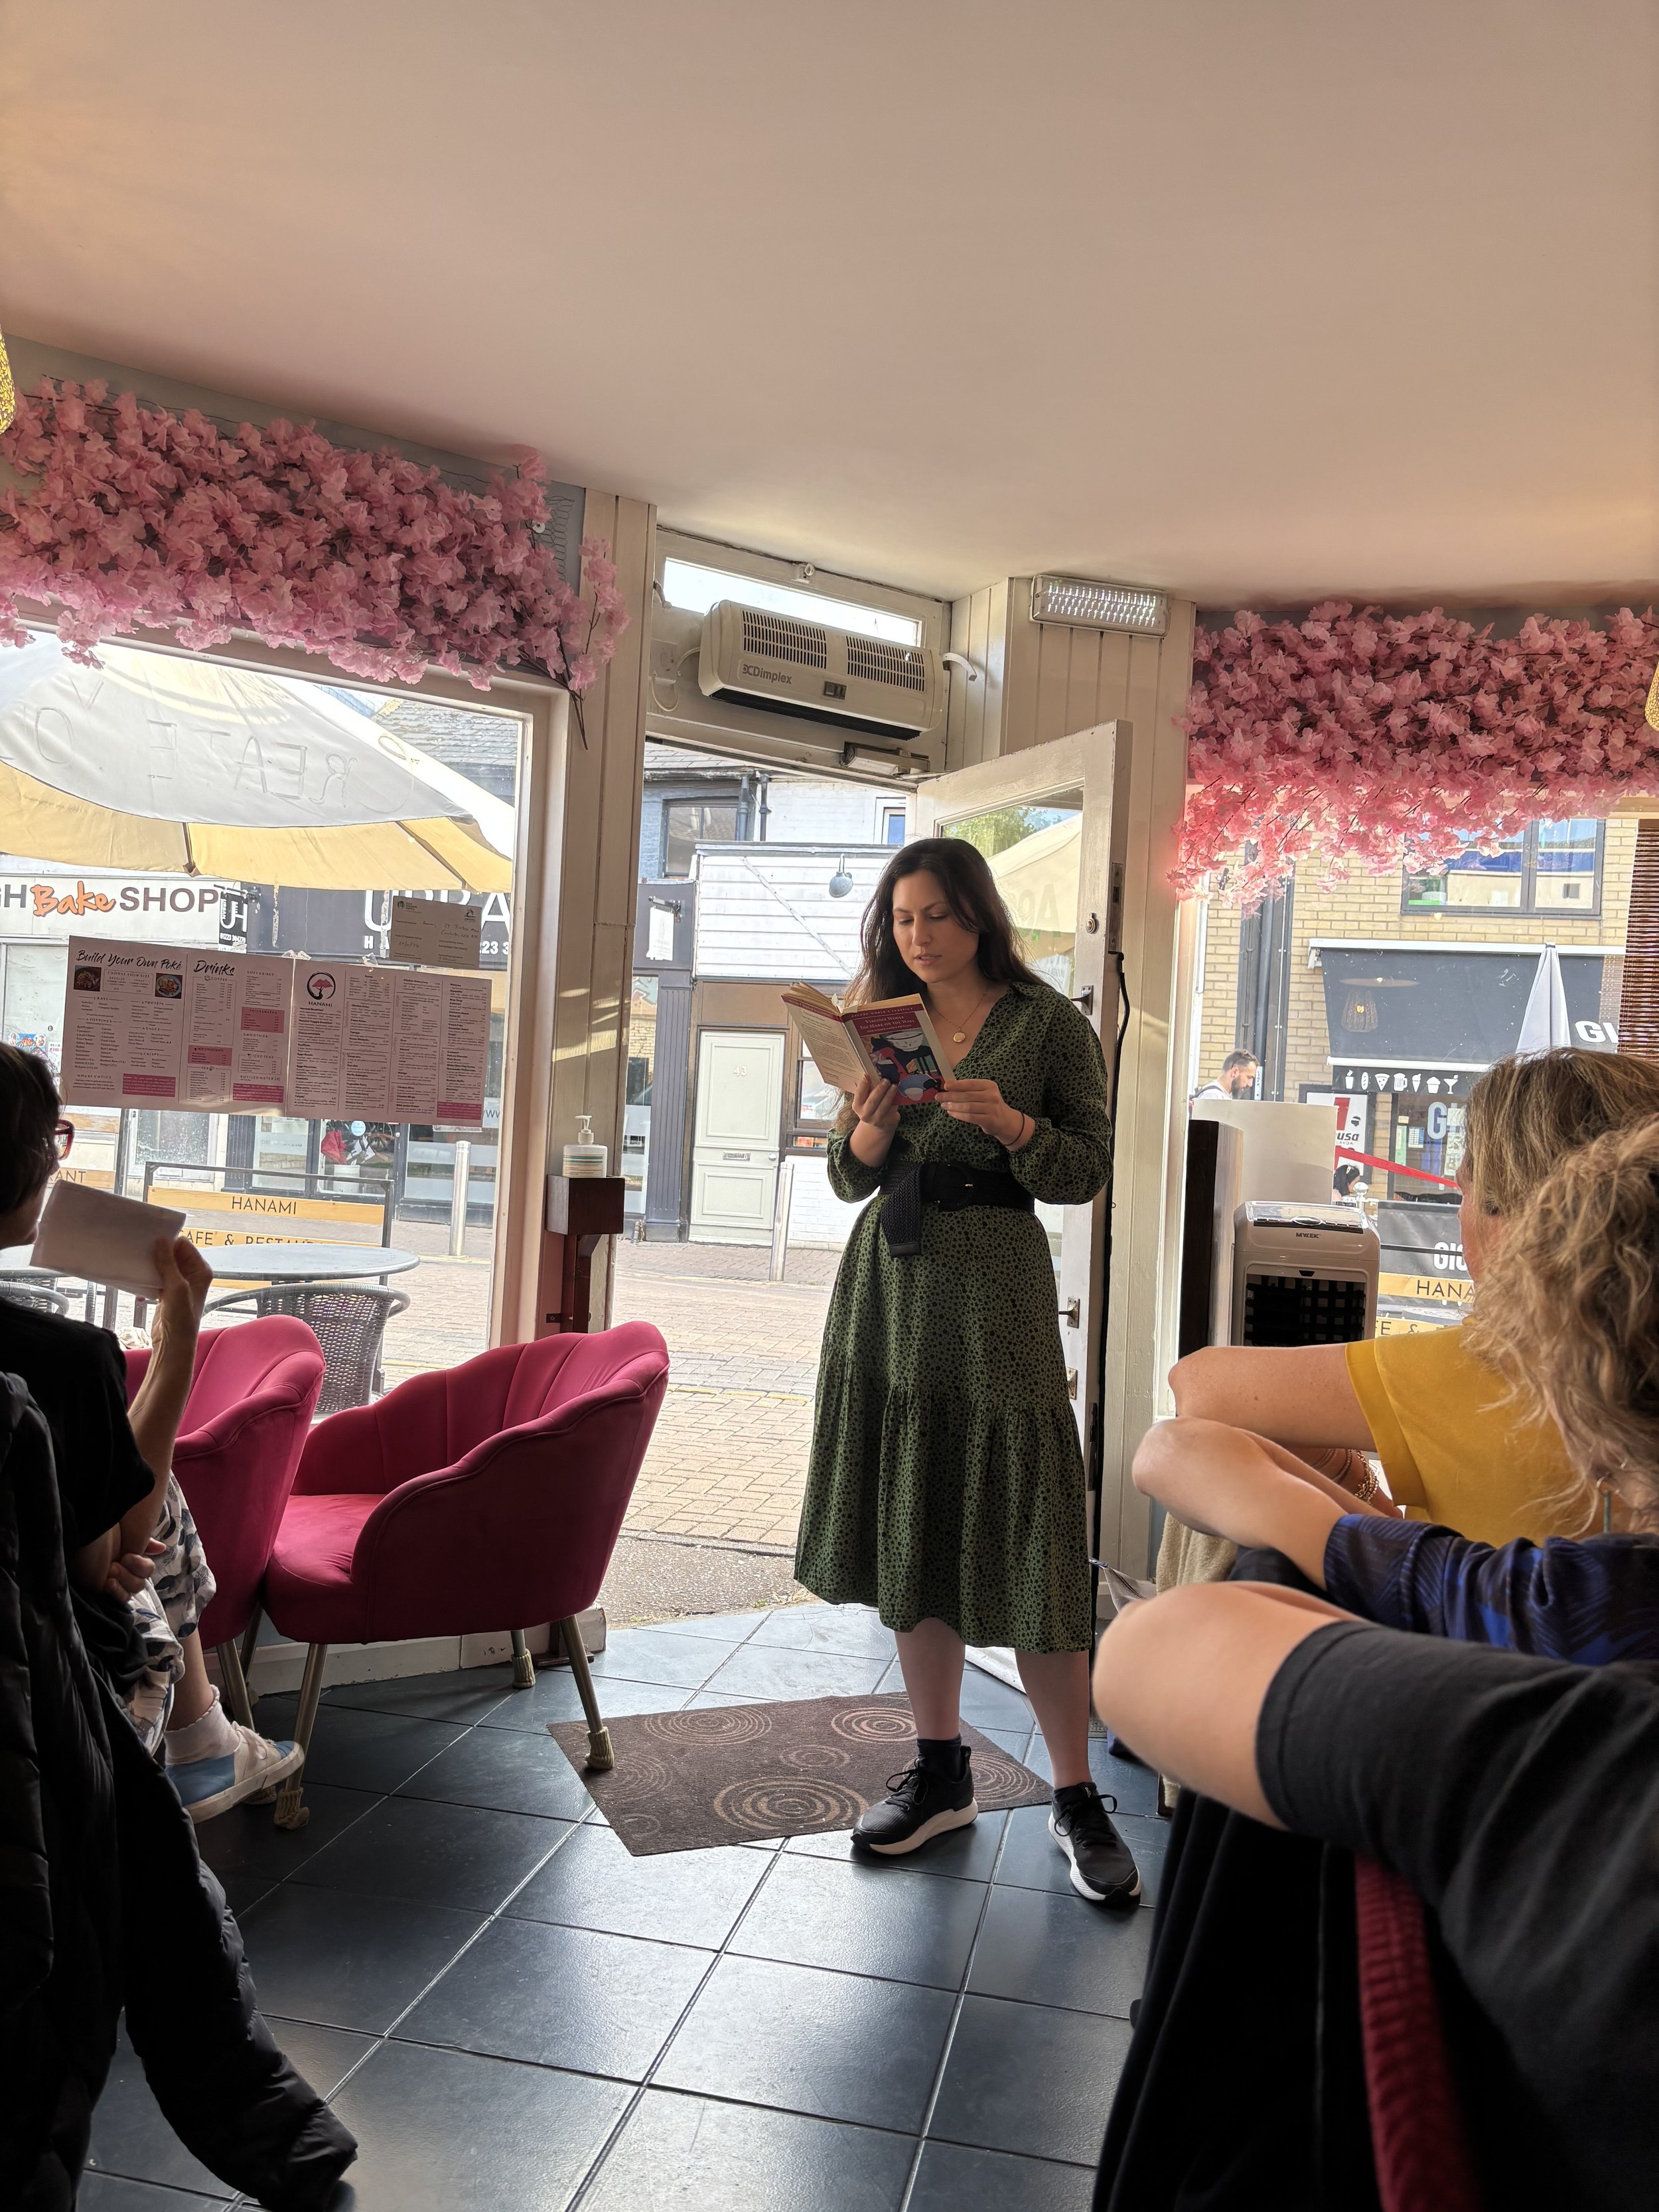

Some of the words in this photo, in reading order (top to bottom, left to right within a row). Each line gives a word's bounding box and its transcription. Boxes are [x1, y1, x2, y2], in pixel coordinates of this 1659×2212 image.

[753, 666, 792, 684] Dimplex
[0, 884, 27, 908] H
[30, 881, 115, 917] Bake
[119, 887, 219, 913] SHOP
[364, 935, 390, 950] HA
[480, 940, 498, 954] 23
[76, 950, 106, 963] Build
[108, 953, 134, 967] Your
[136, 956, 158, 968] Own
[194, 960, 235, 976] Drinks
[1575, 1021, 1619, 1044] GI
[733, 1067, 748, 1076] 43
[232, 1196, 297, 1215] HANAMI
